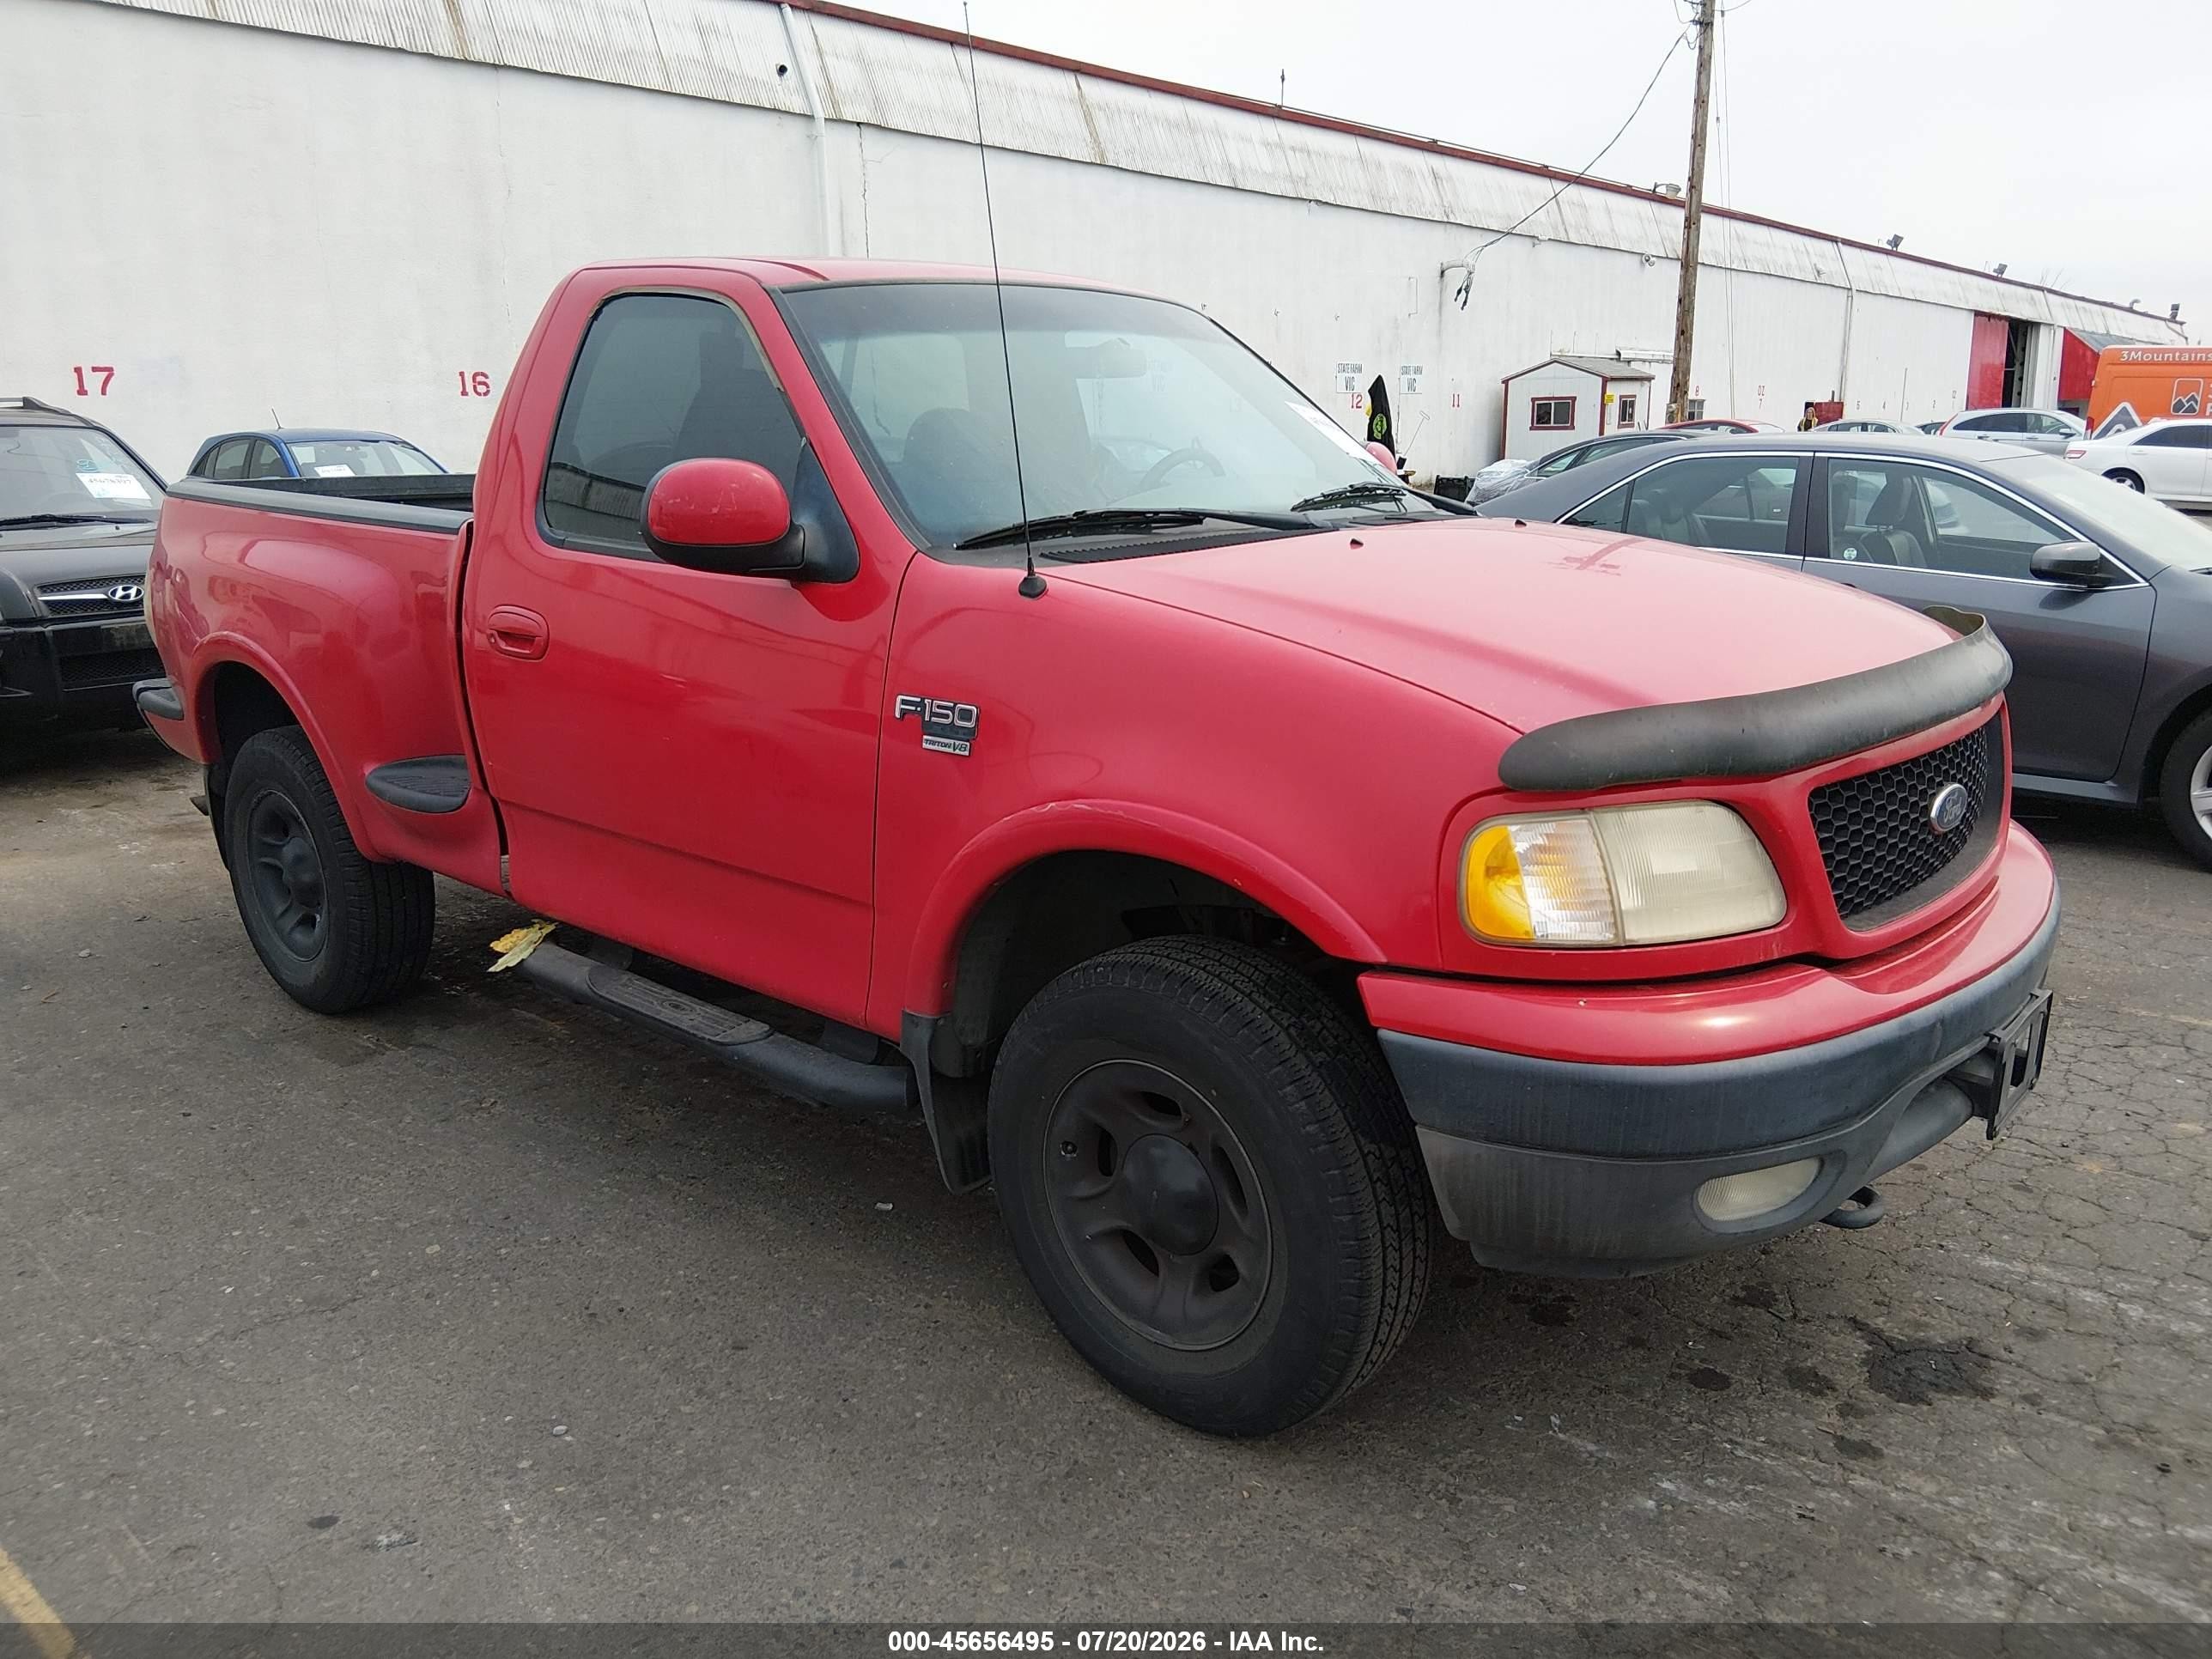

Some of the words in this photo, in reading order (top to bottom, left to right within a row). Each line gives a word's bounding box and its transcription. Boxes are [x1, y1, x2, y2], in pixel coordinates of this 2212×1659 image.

[1337, 362, 1350, 374] STATE
[1350, 363, 1363, 374] FARM
[1401, 365, 1412, 375] STATE
[1412, 365, 1423, 375] FARM
[74, 366, 114, 396] 17
[459, 371, 490, 397] 16
[1345, 376, 1355, 392] VIC
[1407, 378, 1417, 392] VIC
[1351, 394, 1363, 409] 12
[1451, 393, 1461, 408] 11
[924, 738, 951, 749] TRITON
[952, 741, 968, 752] V8
[1944, 790, 1962, 823] Ford
